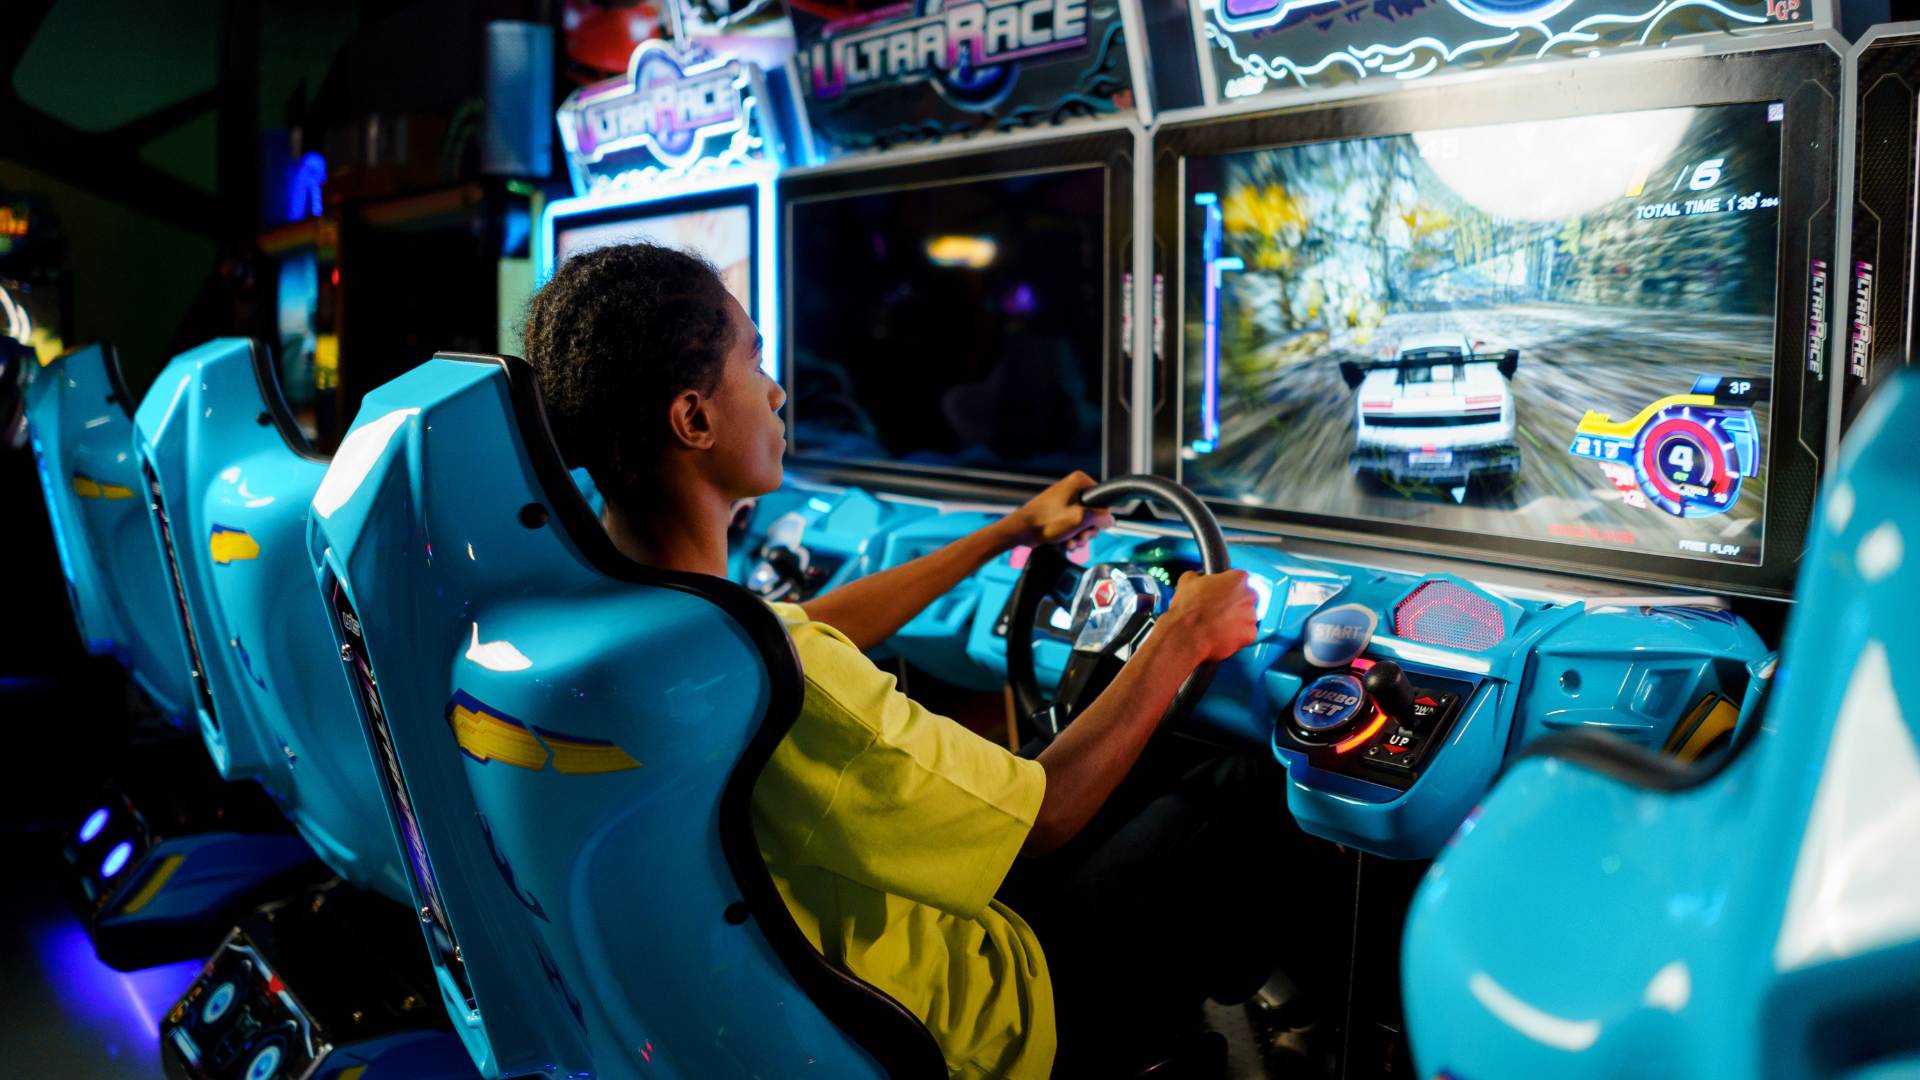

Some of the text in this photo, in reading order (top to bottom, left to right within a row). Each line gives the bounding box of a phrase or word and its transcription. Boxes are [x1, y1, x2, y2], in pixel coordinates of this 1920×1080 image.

[1636, 201, 1681, 219] TOTAL
[1684, 198, 1720, 214] TIME
[1729, 381, 1751, 395] 3P
[1668, 445, 1694, 472] 4
[1679, 539, 1740, 556] FREE PLAY
[1314, 623, 1363, 639] START
[1308, 687, 1359, 706] TURBO
[1302, 700, 1344, 717] JET
[1414, 704, 1436, 715] OWN
[1389, 734, 1410, 746] UP
